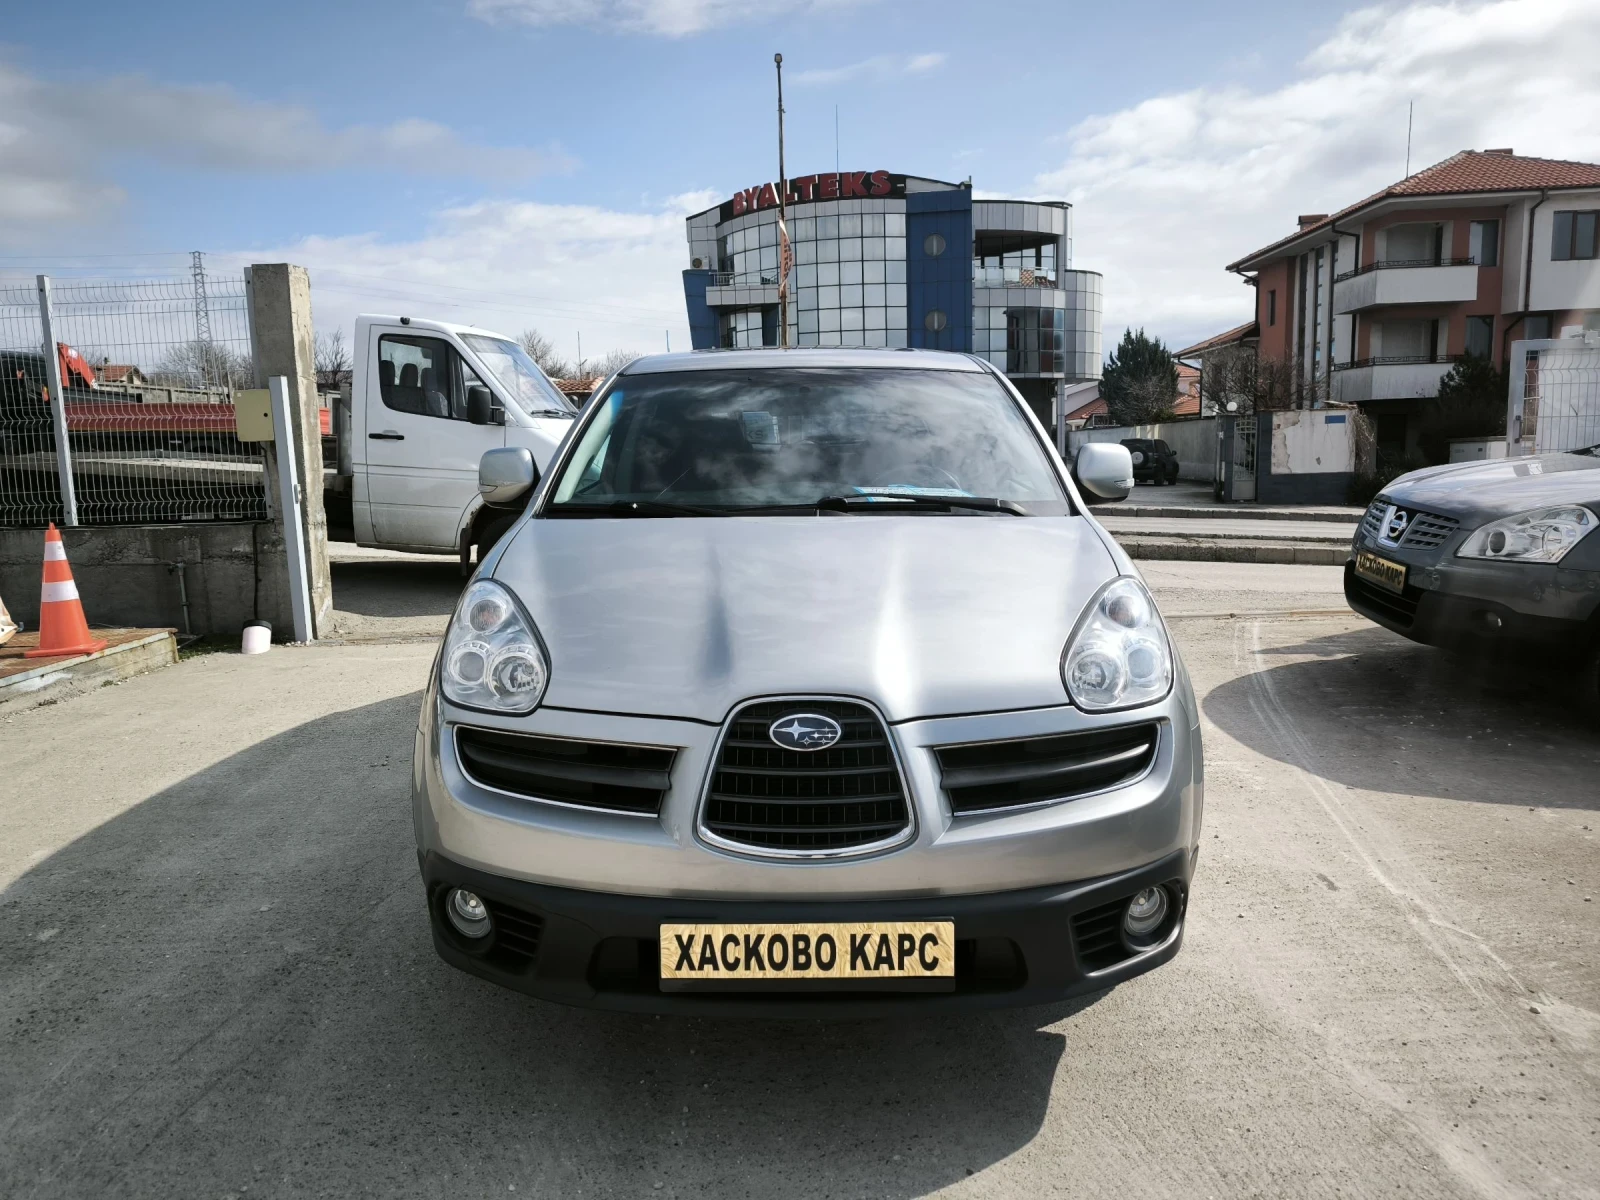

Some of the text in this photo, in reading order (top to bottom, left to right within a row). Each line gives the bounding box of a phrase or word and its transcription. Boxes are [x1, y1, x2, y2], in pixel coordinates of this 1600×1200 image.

[733, 169, 893, 216] BYALTEKS
[674, 933, 940, 972] ХАСКОВО КАРС
